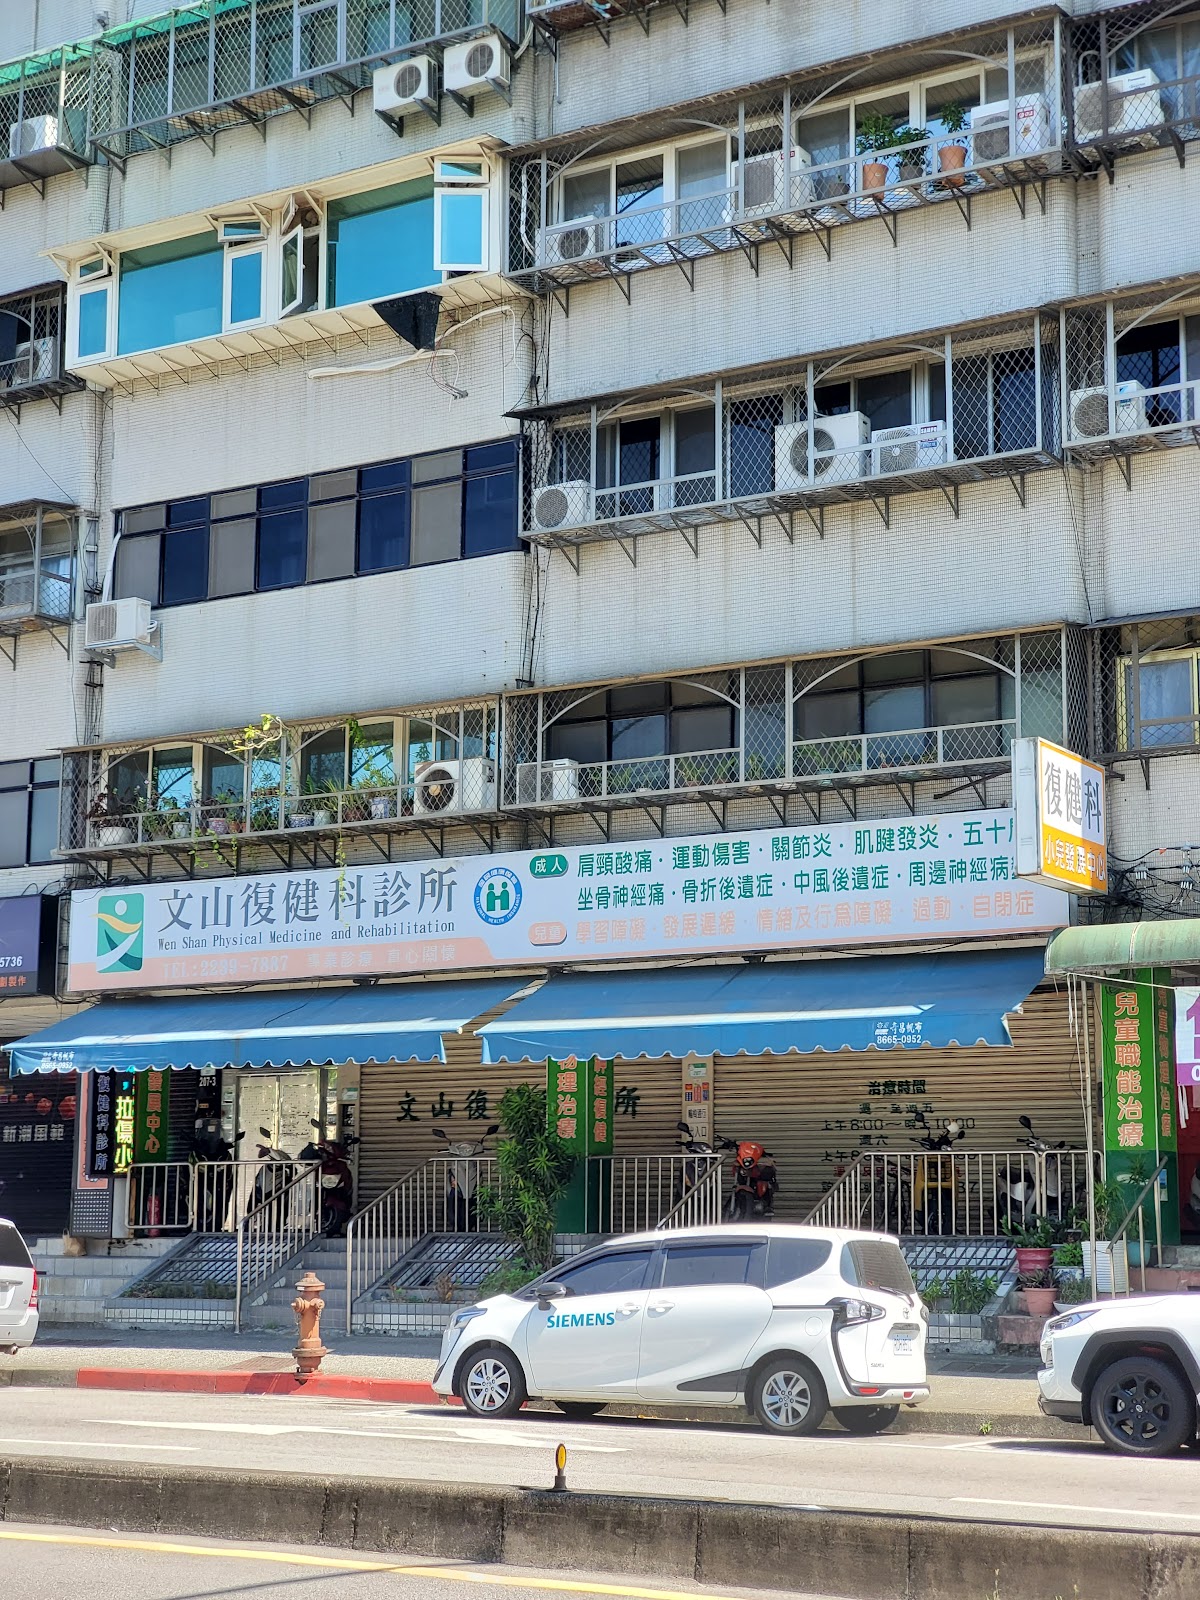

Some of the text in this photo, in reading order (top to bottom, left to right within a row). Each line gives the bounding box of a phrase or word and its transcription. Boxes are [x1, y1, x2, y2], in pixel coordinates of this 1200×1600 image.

[1044, 762, 1102, 833] 復健科
[534, 858, 563, 873] 成人
[1045, 835, 1106, 881] 小兒發展中心
[158, 866, 457, 932] 文山復健科診所
[158, 920, 455, 951] Wen Shan Physical Medicine and Rehabilitation
[533, 925, 562, 941] 兒童
[876, 1034, 922, 1045] 8665-0952
[1113, 991, 1144, 1147] 兒童職能治療
[199, 1077, 217, 1087] 207-3
[868, 1079, 926, 1096] 治療時間
[546, 1312, 615, 1328] SIEMENS
